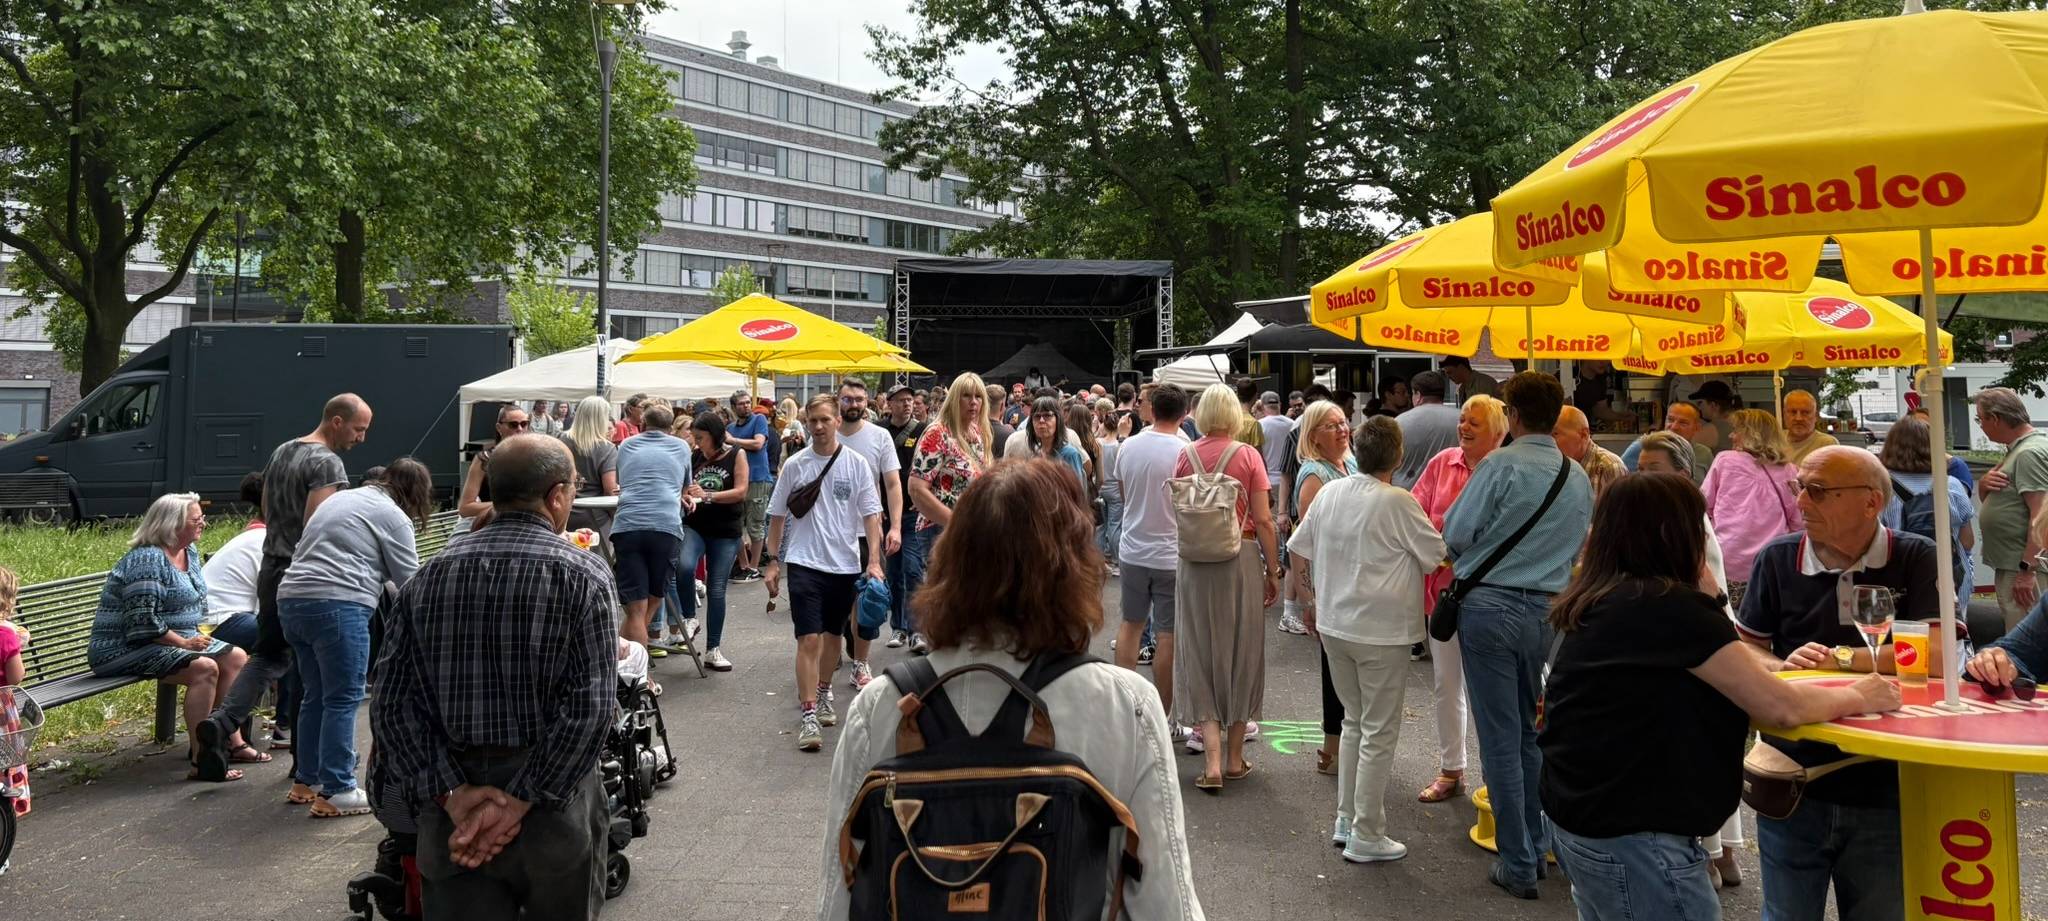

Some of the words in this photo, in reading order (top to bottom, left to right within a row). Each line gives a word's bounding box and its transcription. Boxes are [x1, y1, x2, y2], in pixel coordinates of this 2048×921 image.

[1705, 164, 1967, 221] Sinalco
[1515, 199, 1606, 251] Sinalco
[1326, 286, 1376, 311] Sinalco
[1424, 276, 1536, 299] Sinalco
[1818, 302, 1859, 324] Sinalco
[743, 322, 793, 338] Sinalco
[1690, 349, 1770, 368] Sinalco
[1823, 343, 1901, 362] Sinalco
